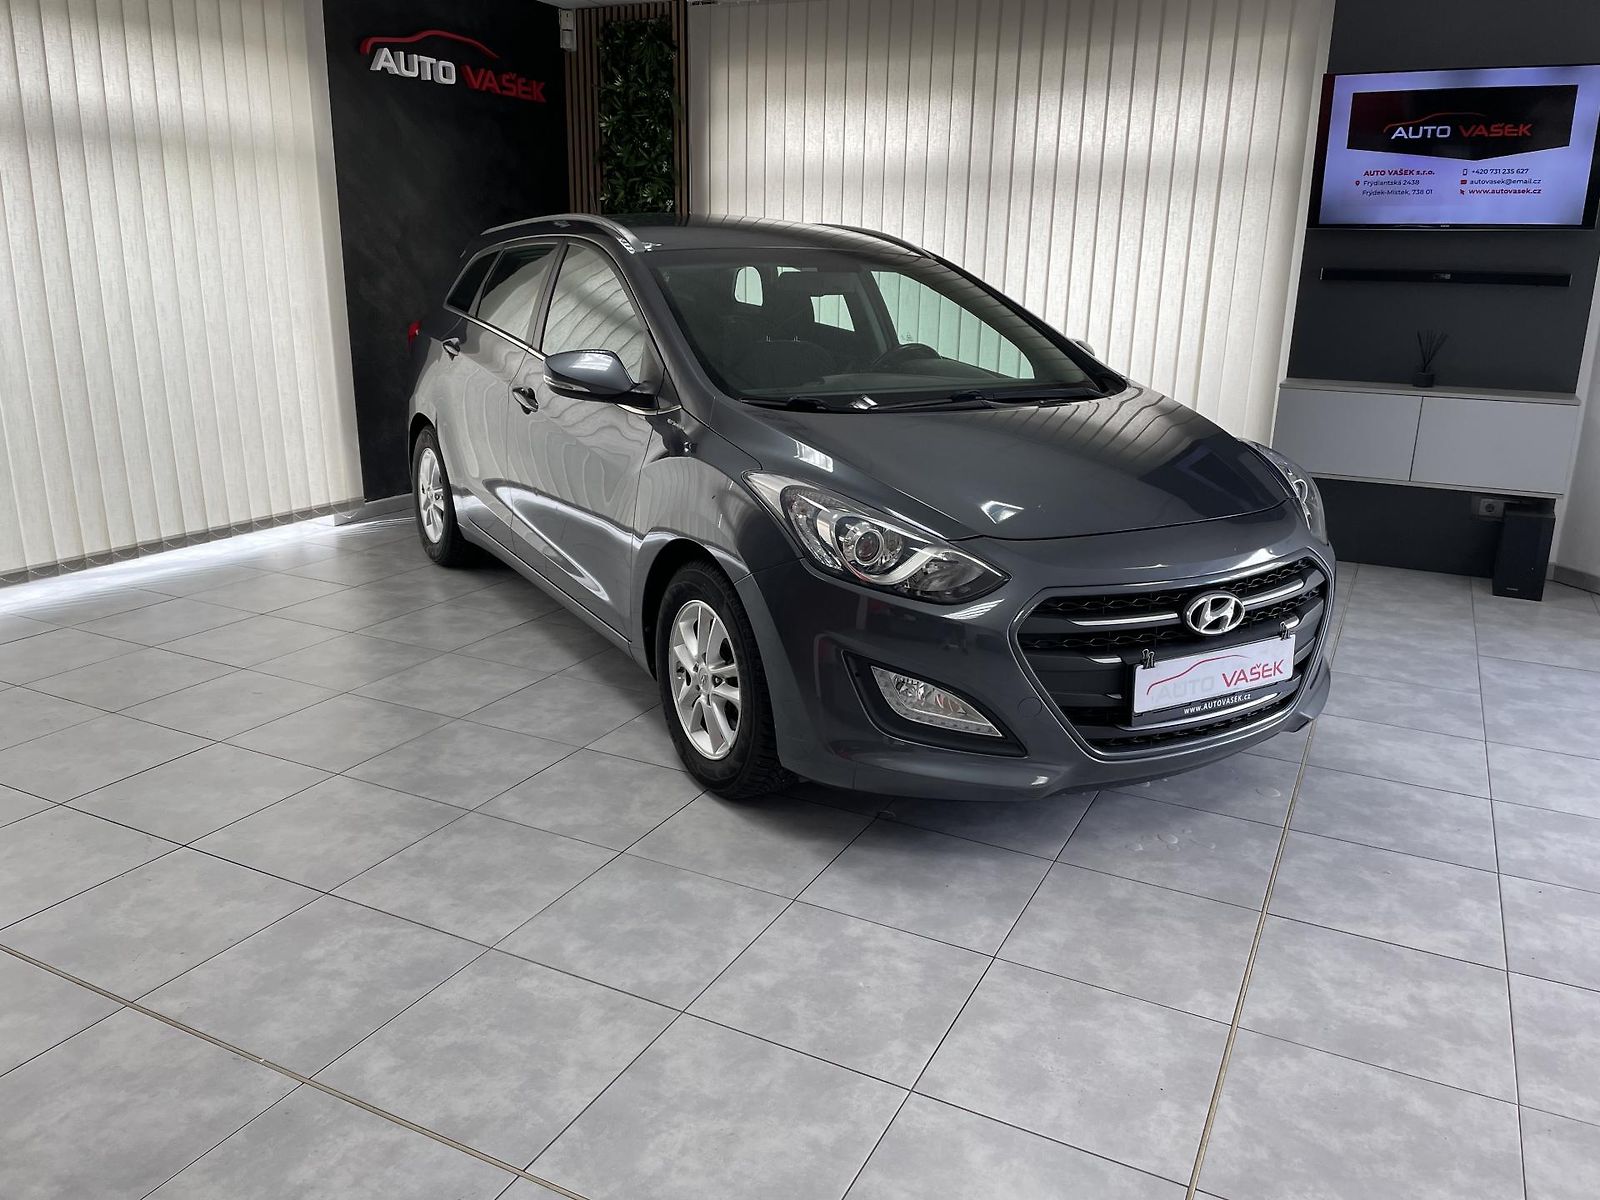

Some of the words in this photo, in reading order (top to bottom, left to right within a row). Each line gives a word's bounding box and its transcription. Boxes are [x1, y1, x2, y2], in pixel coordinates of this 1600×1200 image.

[370, 47, 456, 85] AUTO
[461, 64, 547, 103] VAŠEK
[1391, 126, 1451, 139] AUTO
[1460, 122, 1533, 137] VAŠEK
[1387, 168, 1415, 176] VAŠEK
[1157, 676, 1215, 699] AUTO
[1222, 659, 1284, 688] VAŠEK
